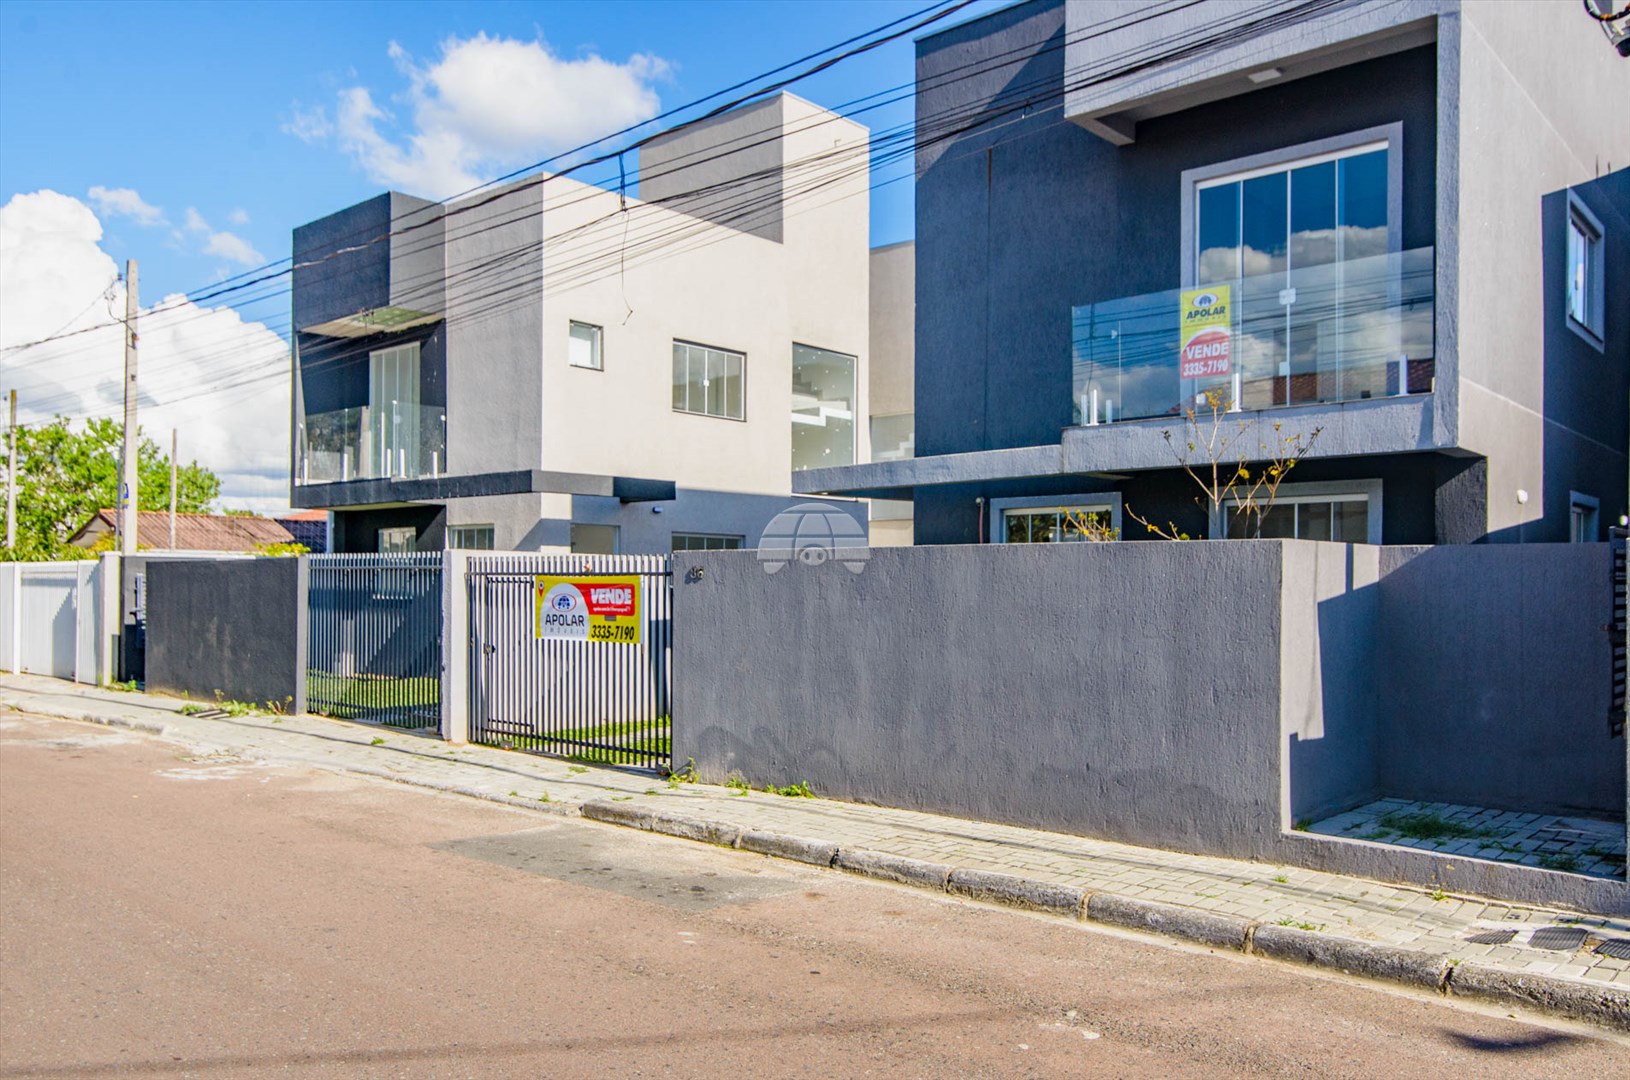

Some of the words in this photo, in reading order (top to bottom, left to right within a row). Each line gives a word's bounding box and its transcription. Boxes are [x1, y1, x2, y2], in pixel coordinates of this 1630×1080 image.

[1186, 306, 1226, 319] APOLAR
[1186, 342, 1229, 360] VENDE
[1183, 359, 1228, 376] 3335-7190
[590, 588, 632, 604] VENDE
[545, 614, 585, 627] APOLAR
[591, 625, 634, 641] 3335-7190
